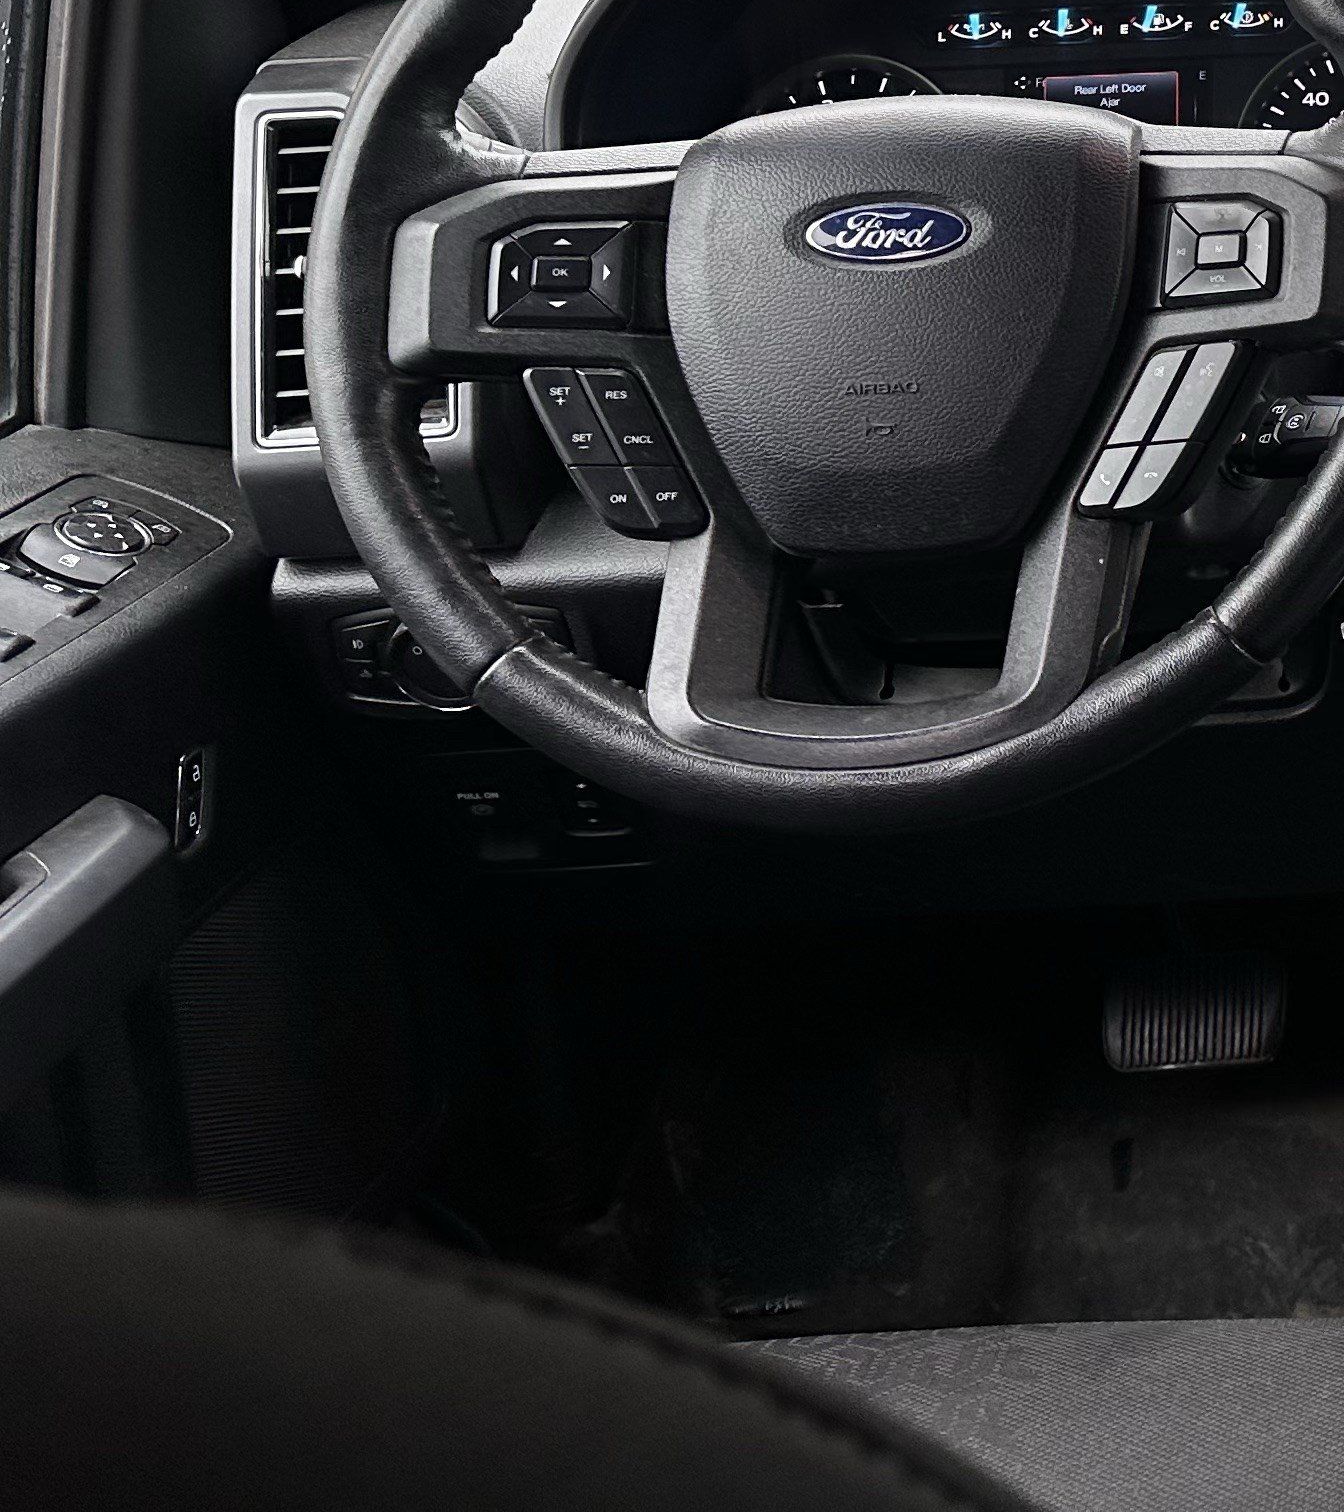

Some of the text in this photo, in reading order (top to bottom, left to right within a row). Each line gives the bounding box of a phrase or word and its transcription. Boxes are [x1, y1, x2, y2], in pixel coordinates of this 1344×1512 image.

[1184, 21, 1194, 32] F
[1209, 19, 1220, 30] C
[1273, 17, 1284, 29] H
[1029, 28, 1039, 38] C
[1092, 24, 1103, 36] H
[1120, 24, 1129, 35] E
[937, 31, 947, 43] L
[1001, 30, 1012, 41] H
[1074, 82, 1147, 95] Rear Left Door
[1100, 96, 1120, 108] Ajar
[1301, 91, 1330, 107] 40
[834, 211, 932, 249] Ford
[552, 268, 569, 276] OK
[549, 386, 570, 397] SET
[605, 390, 627, 400] RES
[572, 433, 593, 443] SET
[623, 435, 653, 445] CNCL
[610, 494, 627, 504] ON
[656, 492, 678, 502] OFF
